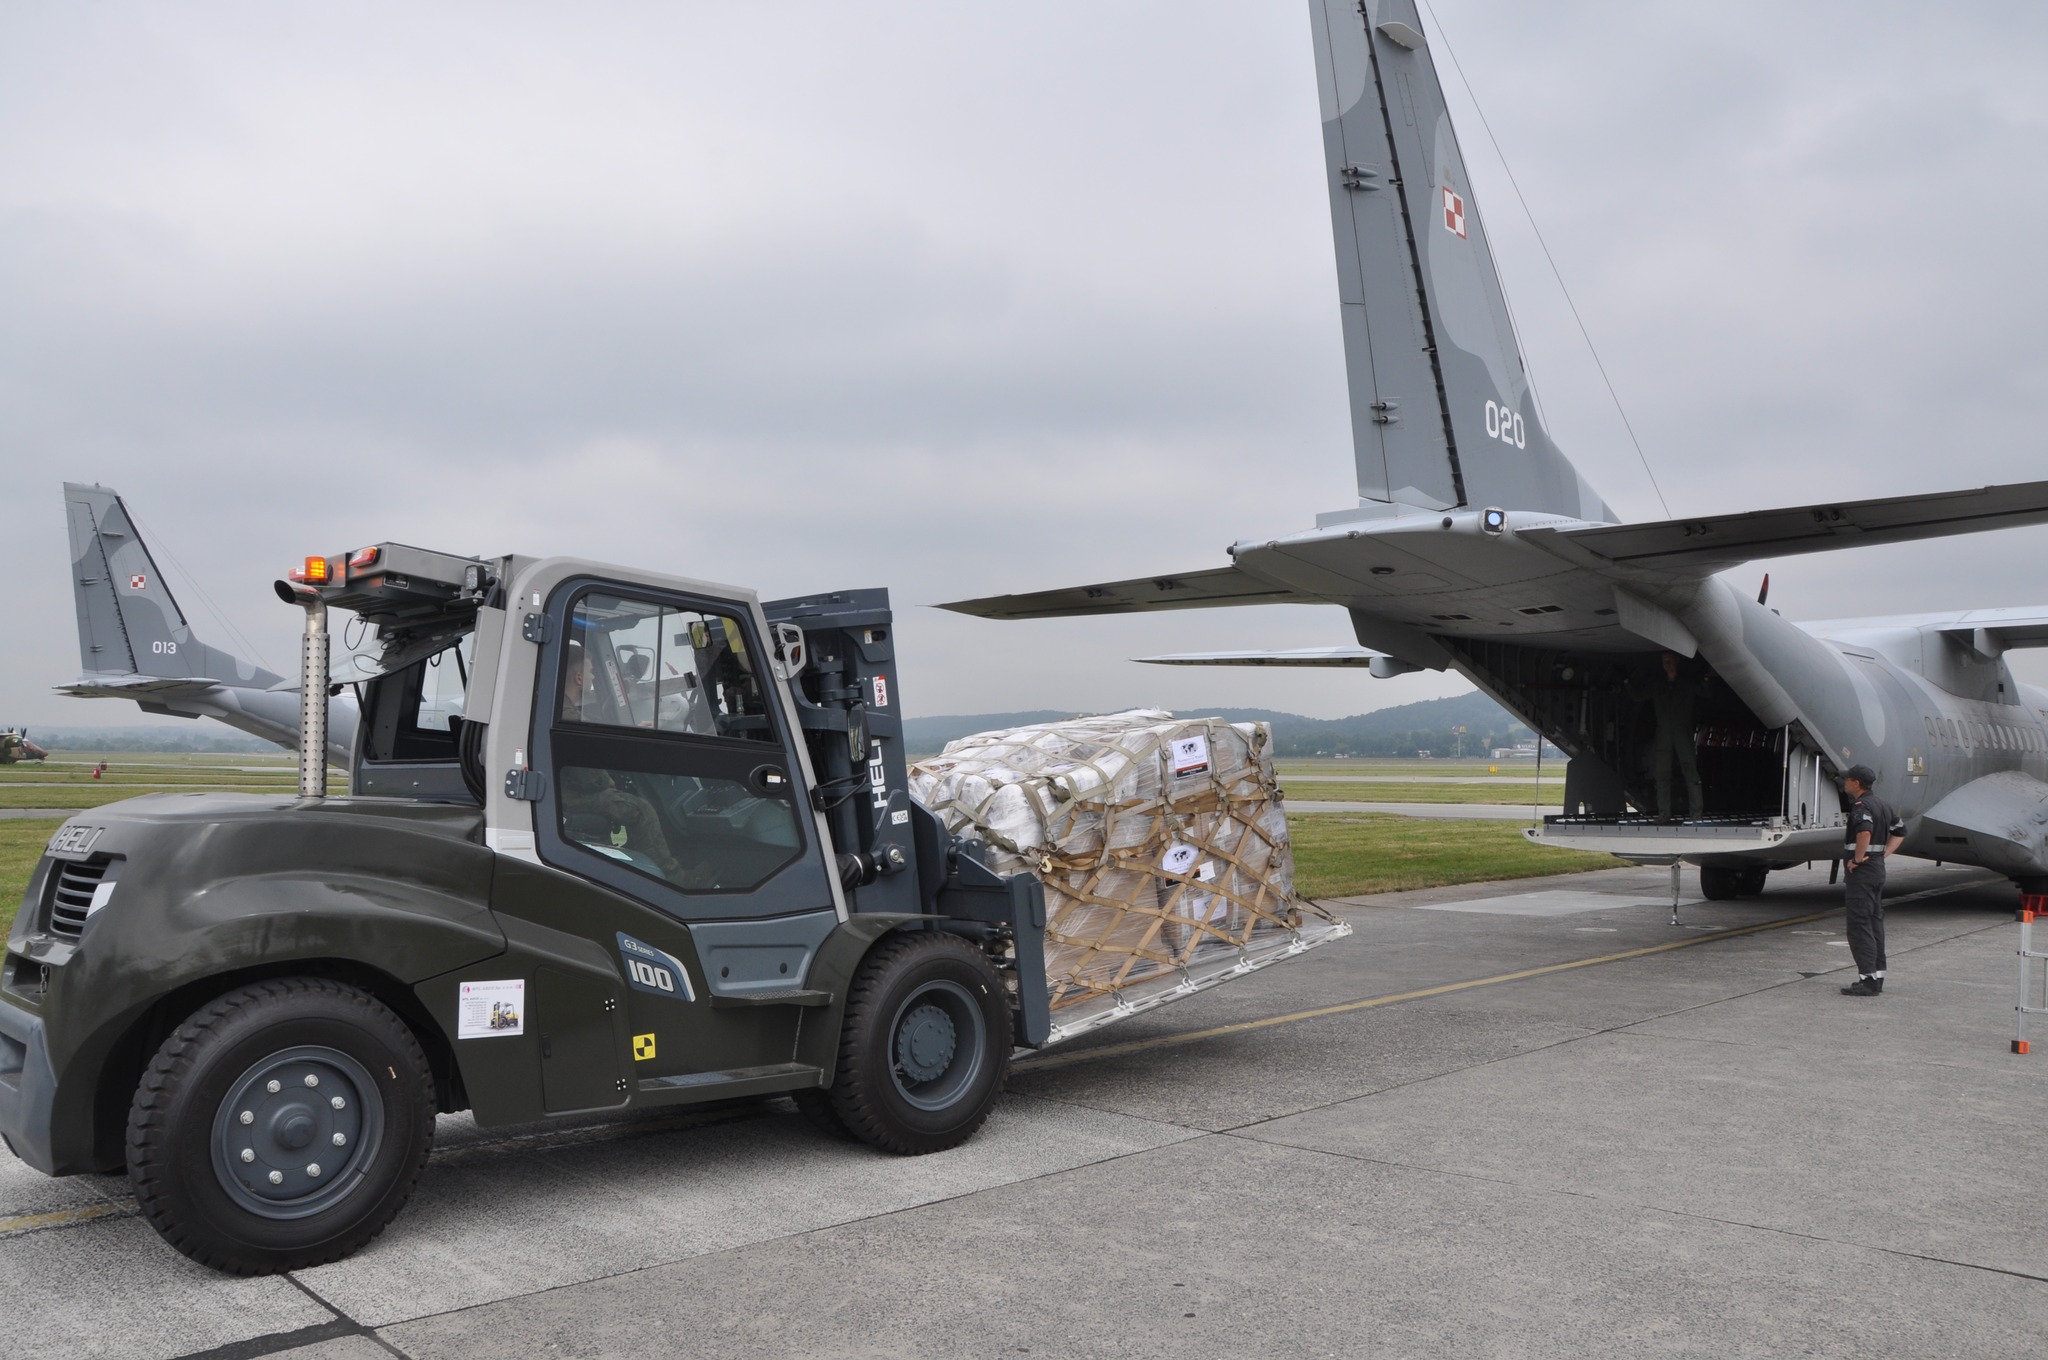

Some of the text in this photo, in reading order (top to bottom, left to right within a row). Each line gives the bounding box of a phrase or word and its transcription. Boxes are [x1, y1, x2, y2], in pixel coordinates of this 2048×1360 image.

[1485, 399, 1526, 450] 020
[152, 640, 177, 655] 013
[869, 738, 888, 809] HELI
[50, 826, 105, 853] HELI
[624, 939, 655, 957] G3 SERIES
[628, 959, 674, 992] 100
